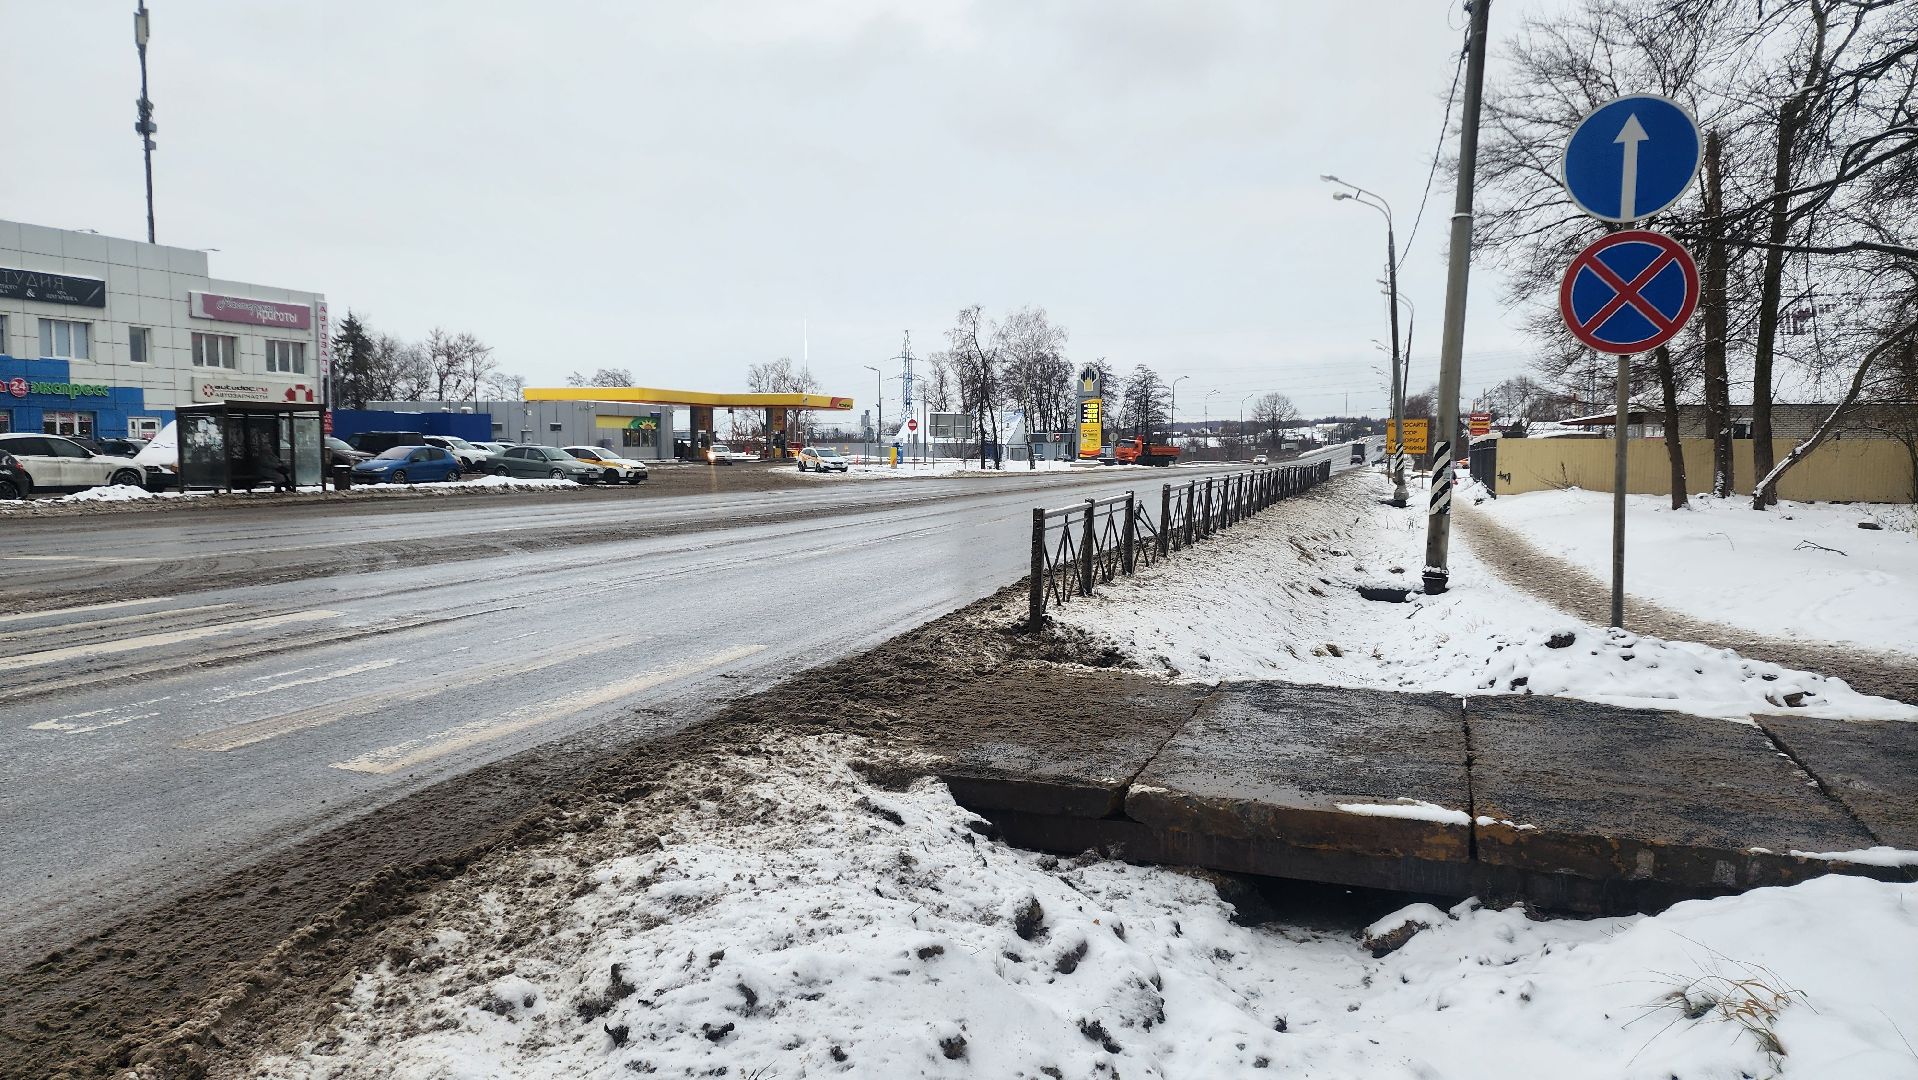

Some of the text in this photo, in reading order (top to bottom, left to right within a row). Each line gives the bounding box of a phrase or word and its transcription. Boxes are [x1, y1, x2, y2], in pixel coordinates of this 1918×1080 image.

[3, 270, 64, 290] ТУДИЯ
[11, 381, 27, 390] 24
[30, 381, 109, 399] экспресс
